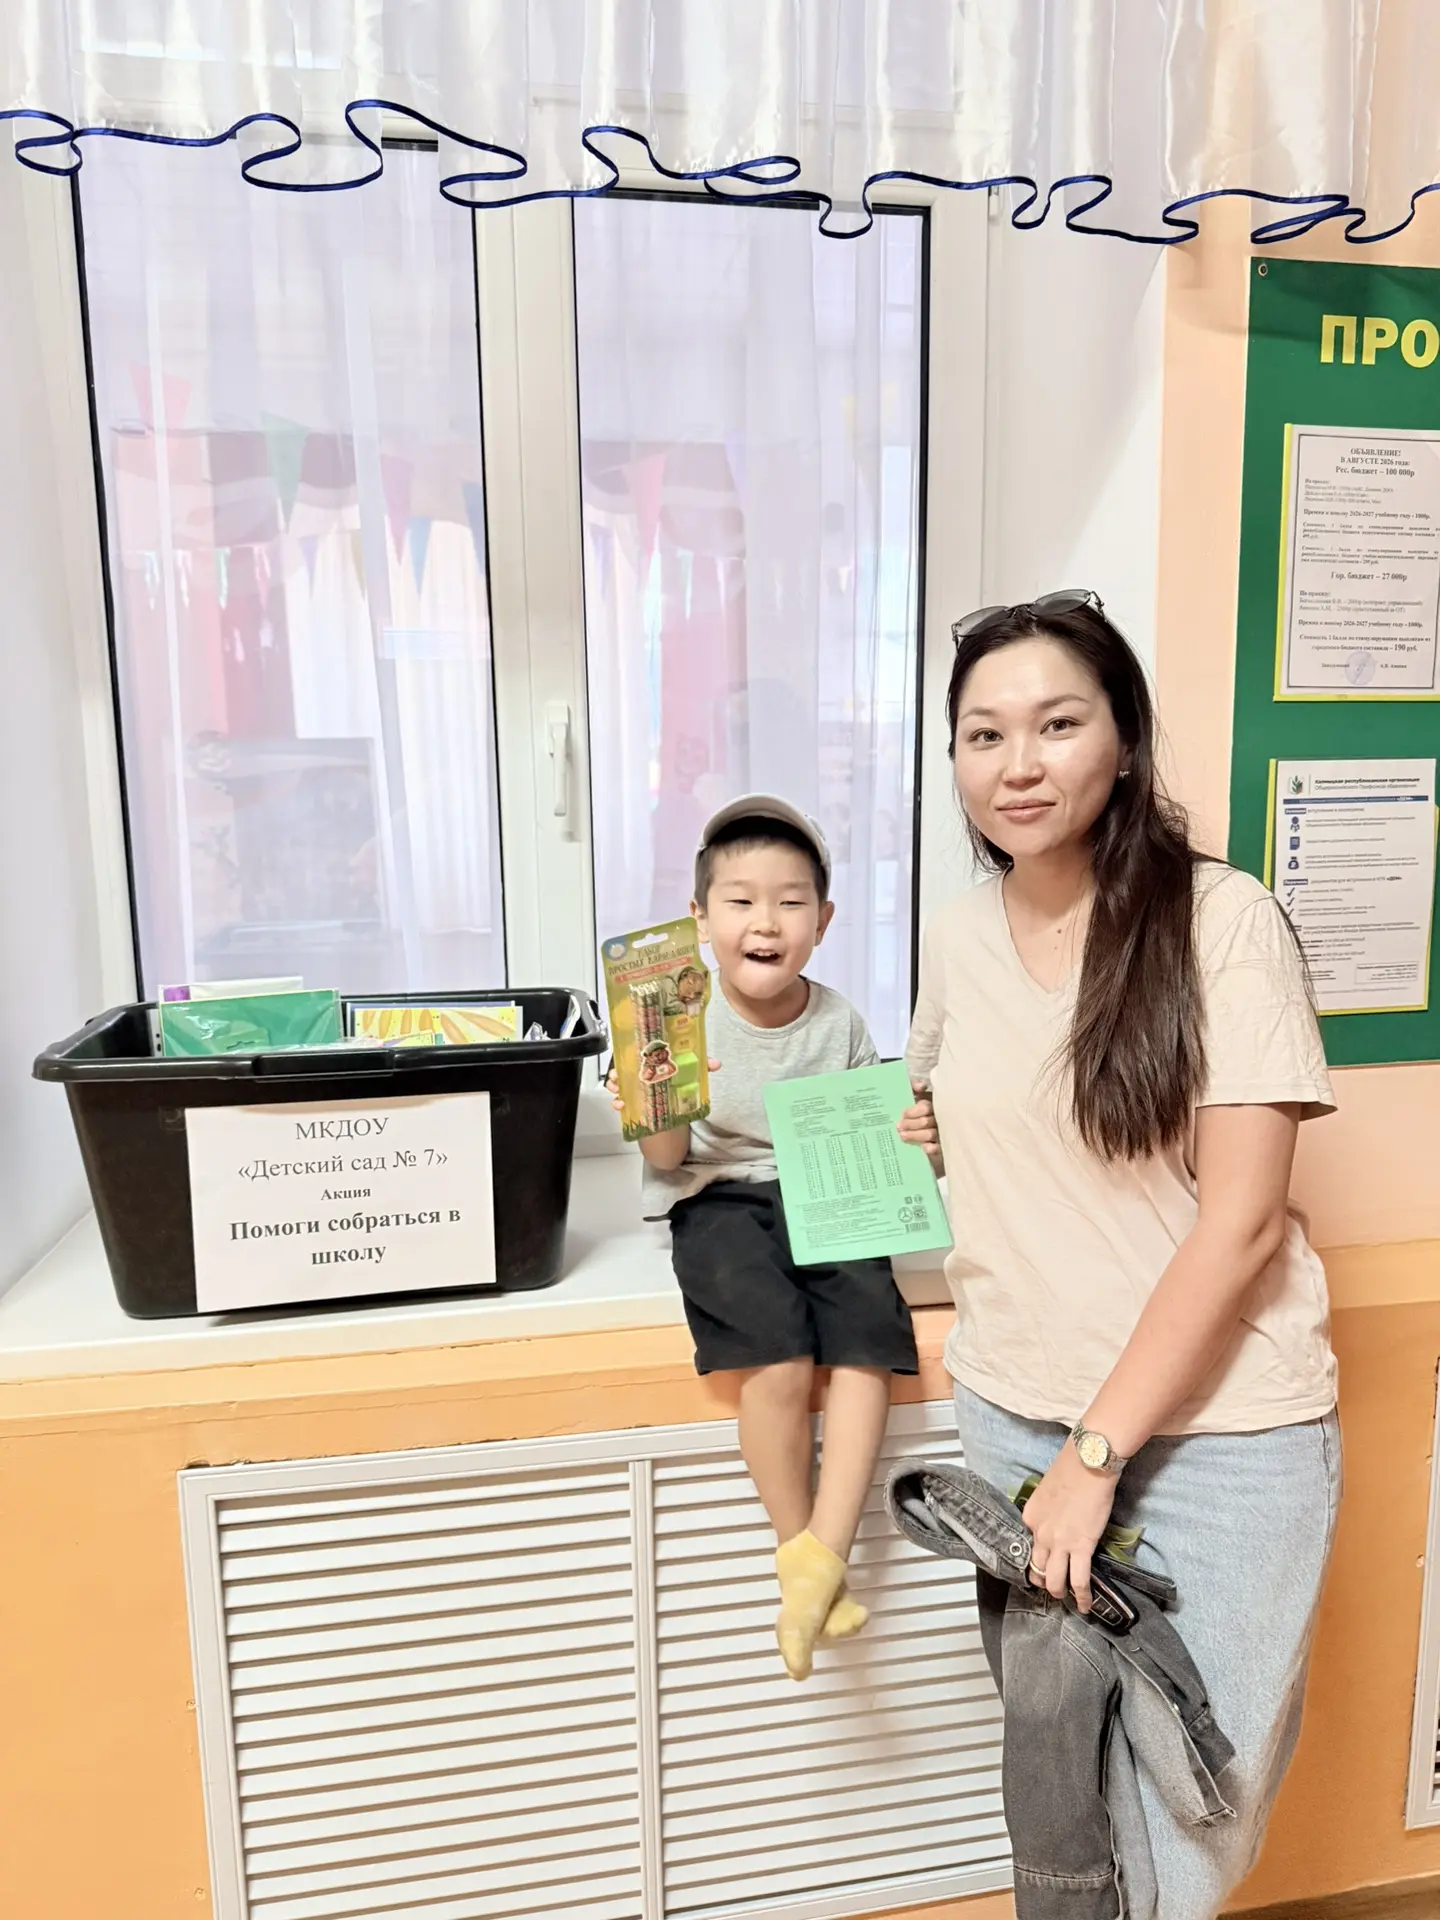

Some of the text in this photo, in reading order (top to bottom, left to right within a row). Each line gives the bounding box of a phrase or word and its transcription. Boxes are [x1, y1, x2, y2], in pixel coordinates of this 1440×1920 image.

[1320, 314, 1439, 368] ПРО
[1350, 448, 1401, 456] ОБЪЯВЛЕНИЕ!
[1346, 457, 1380, 465] АВГУСТЕ
[1336, 466, 1350, 474] Рес.
[1350, 466, 1378, 475] бюджет
[1331, 572, 1346, 580] Гор.
[1347, 571, 1374, 580] бюджет
[295, 1117, 390, 1142] МКДОУ
[238, 1148, 448, 1181] «Детский сад № 7»
[321, 1188, 372, 1202] Акция
[230, 1208, 462, 1242] Помоги собраться в
[311, 1246, 387, 1266] школу
